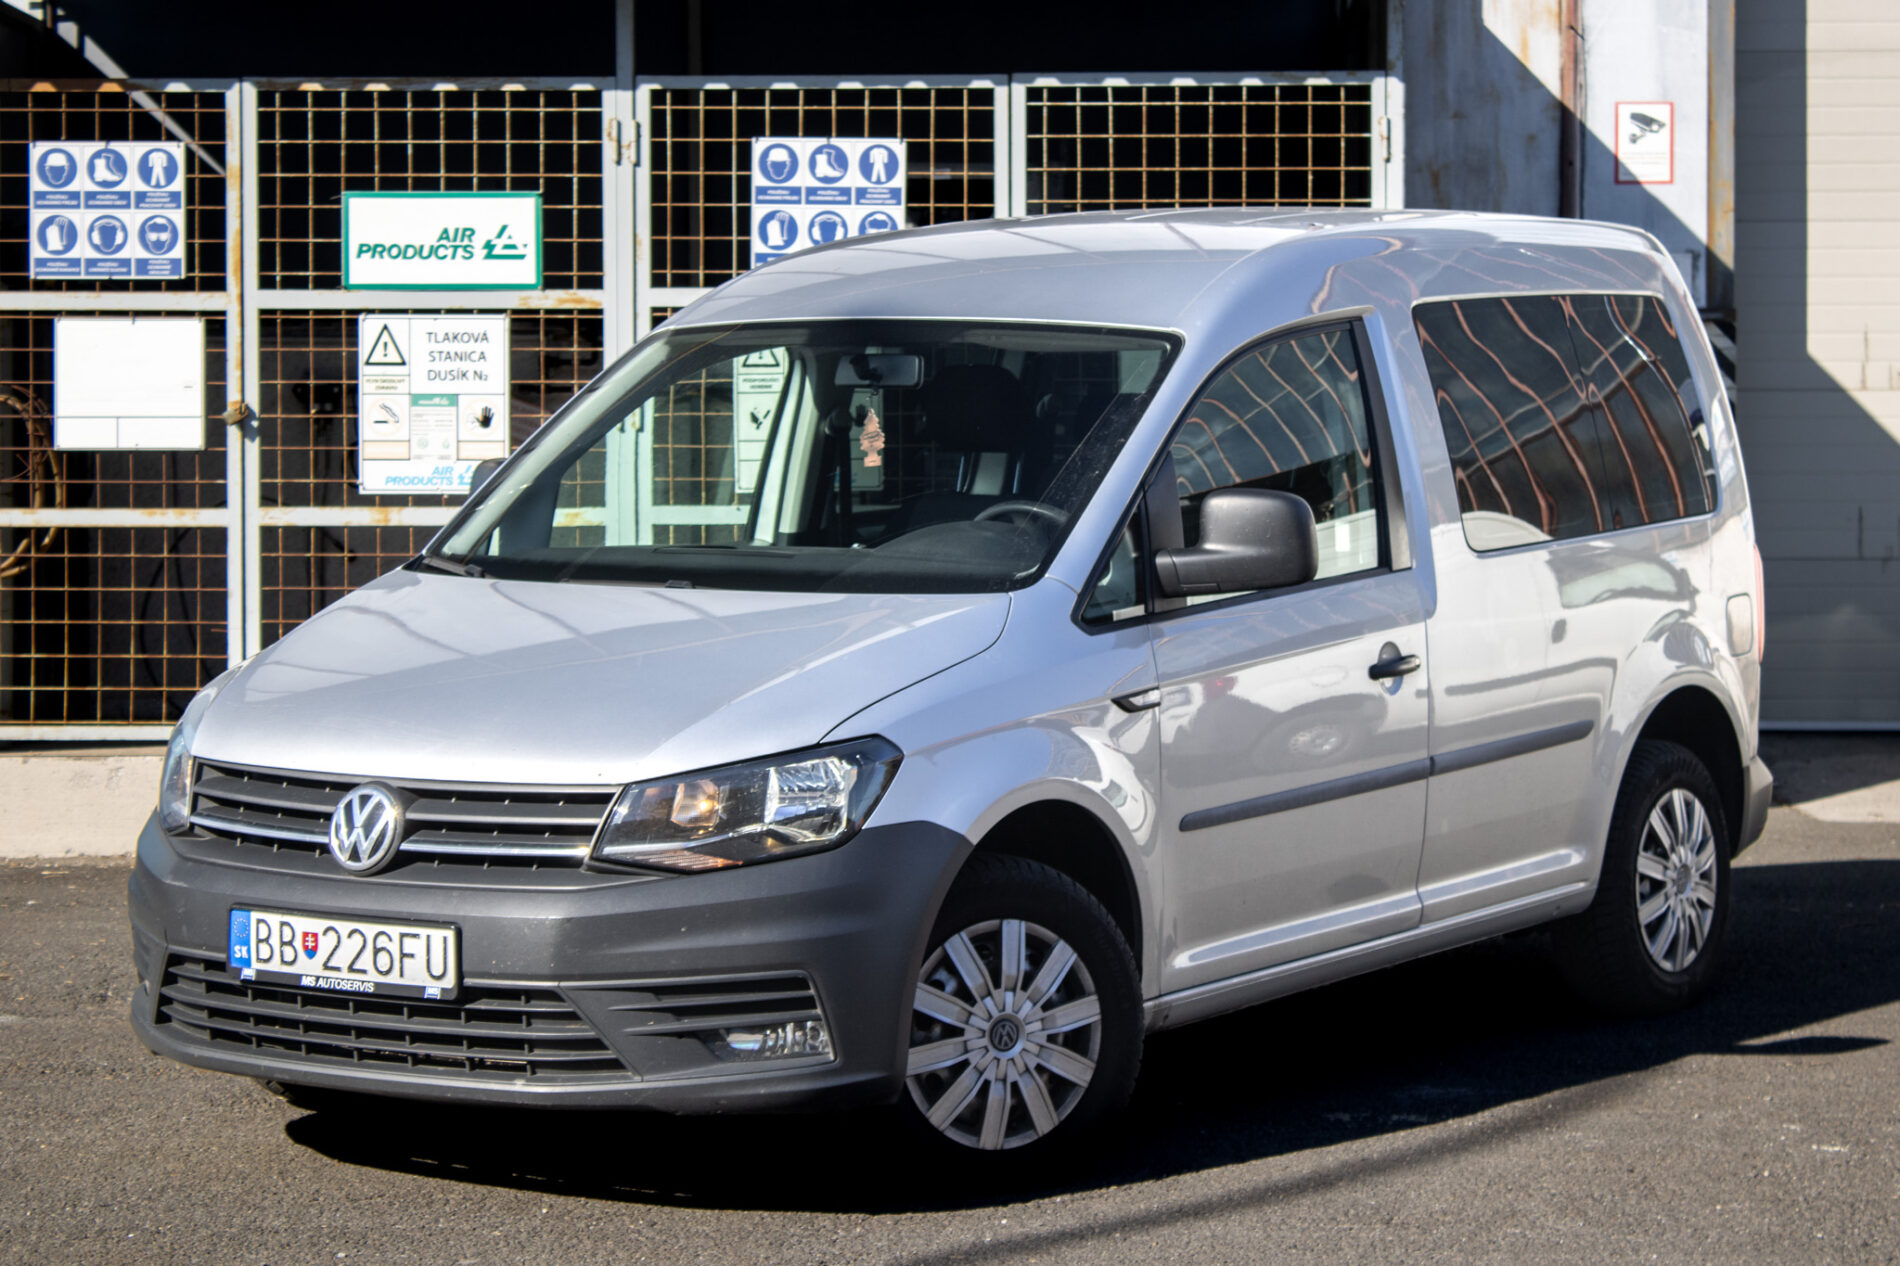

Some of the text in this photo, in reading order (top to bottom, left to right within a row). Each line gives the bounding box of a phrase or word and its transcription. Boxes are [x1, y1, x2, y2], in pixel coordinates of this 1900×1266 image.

[436, 227, 476, 243] AIR
[356, 243, 475, 260] PRODUCTS
[425, 330, 489, 344] TLAKOVÁ
[428, 351, 487, 363] STANICA
[427, 368, 469, 382] DUSÍK
[432, 466, 454, 476] AIR
[385, 476, 454, 486] PRODUCTS
[233, 944, 249, 959] SK
[255, 917, 448, 981] BB 226FU
[300, 975, 375, 992] MS AUTOSERVIS
